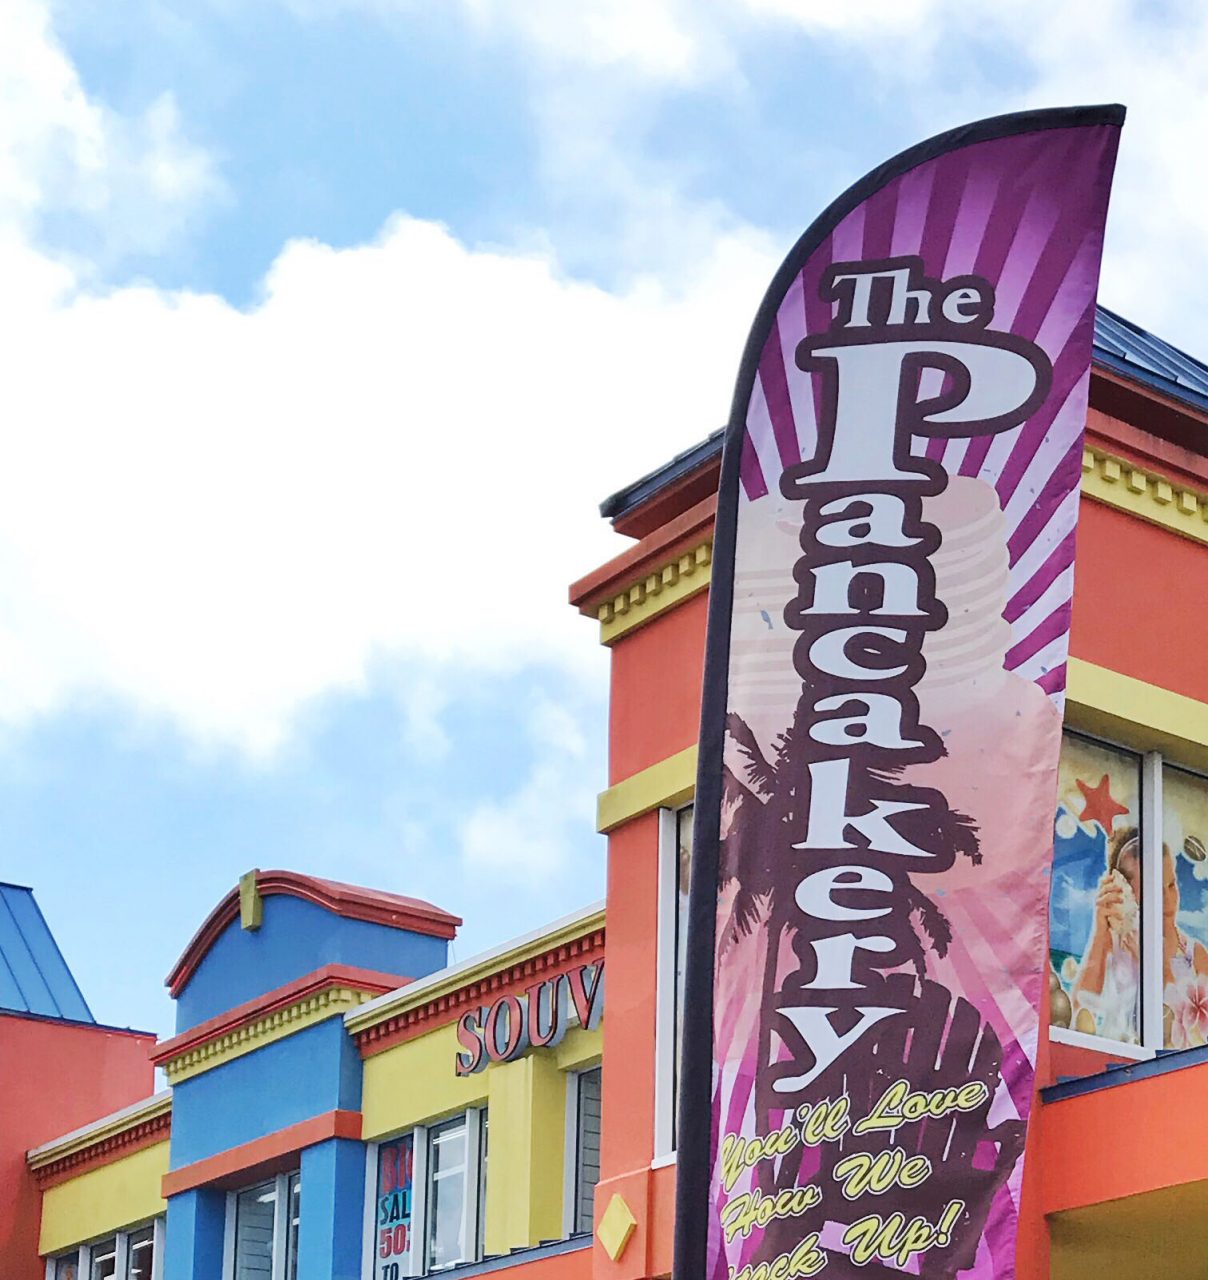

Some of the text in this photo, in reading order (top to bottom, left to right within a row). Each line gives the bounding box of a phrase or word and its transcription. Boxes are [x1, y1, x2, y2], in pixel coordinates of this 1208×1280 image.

[829, 266, 982, 328] The
[772, 339, 1040, 1094] Pancakery
[720, 1079, 989, 1194] You'll Love
[720, 1146, 933, 1244] How We
[841, 1199, 966, 1267] Up!
